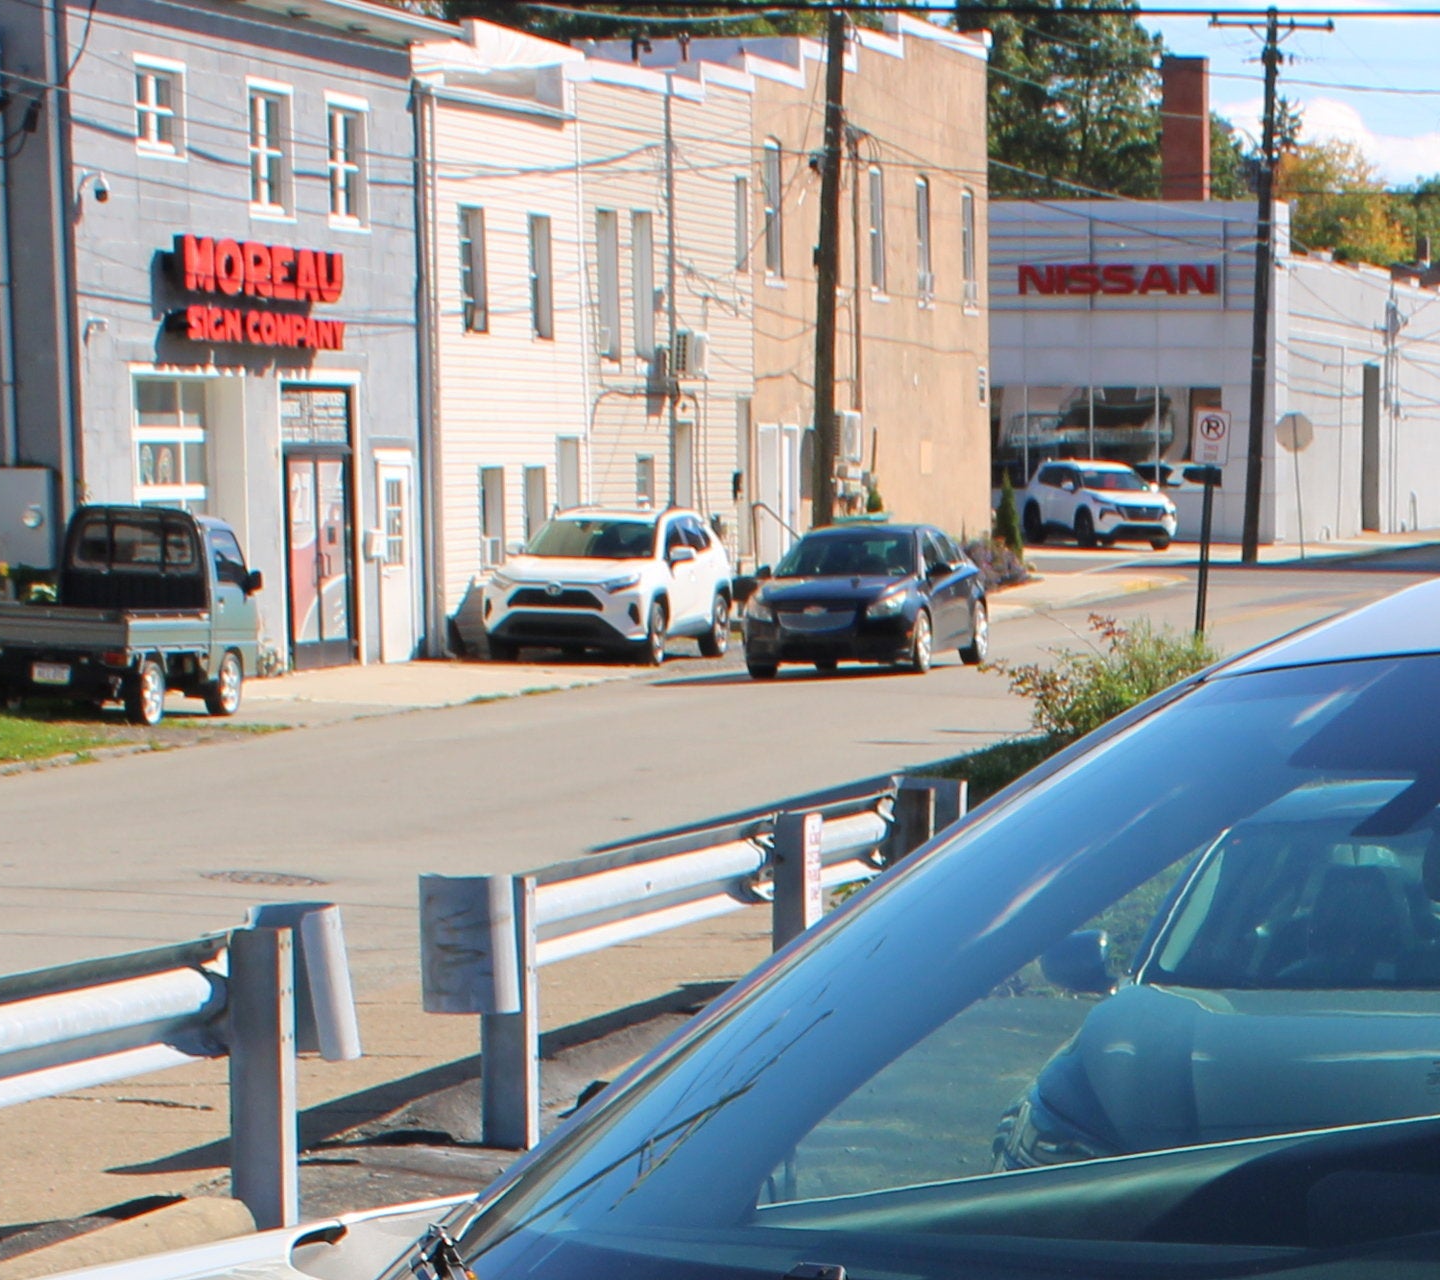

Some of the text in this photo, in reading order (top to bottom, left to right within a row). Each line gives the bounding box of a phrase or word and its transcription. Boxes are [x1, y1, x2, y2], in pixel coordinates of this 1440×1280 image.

[184, 234, 343, 303] MOREAU
[1018, 264, 1216, 295] NISSAN
[187, 304, 345, 350] SIGN COMPANY
